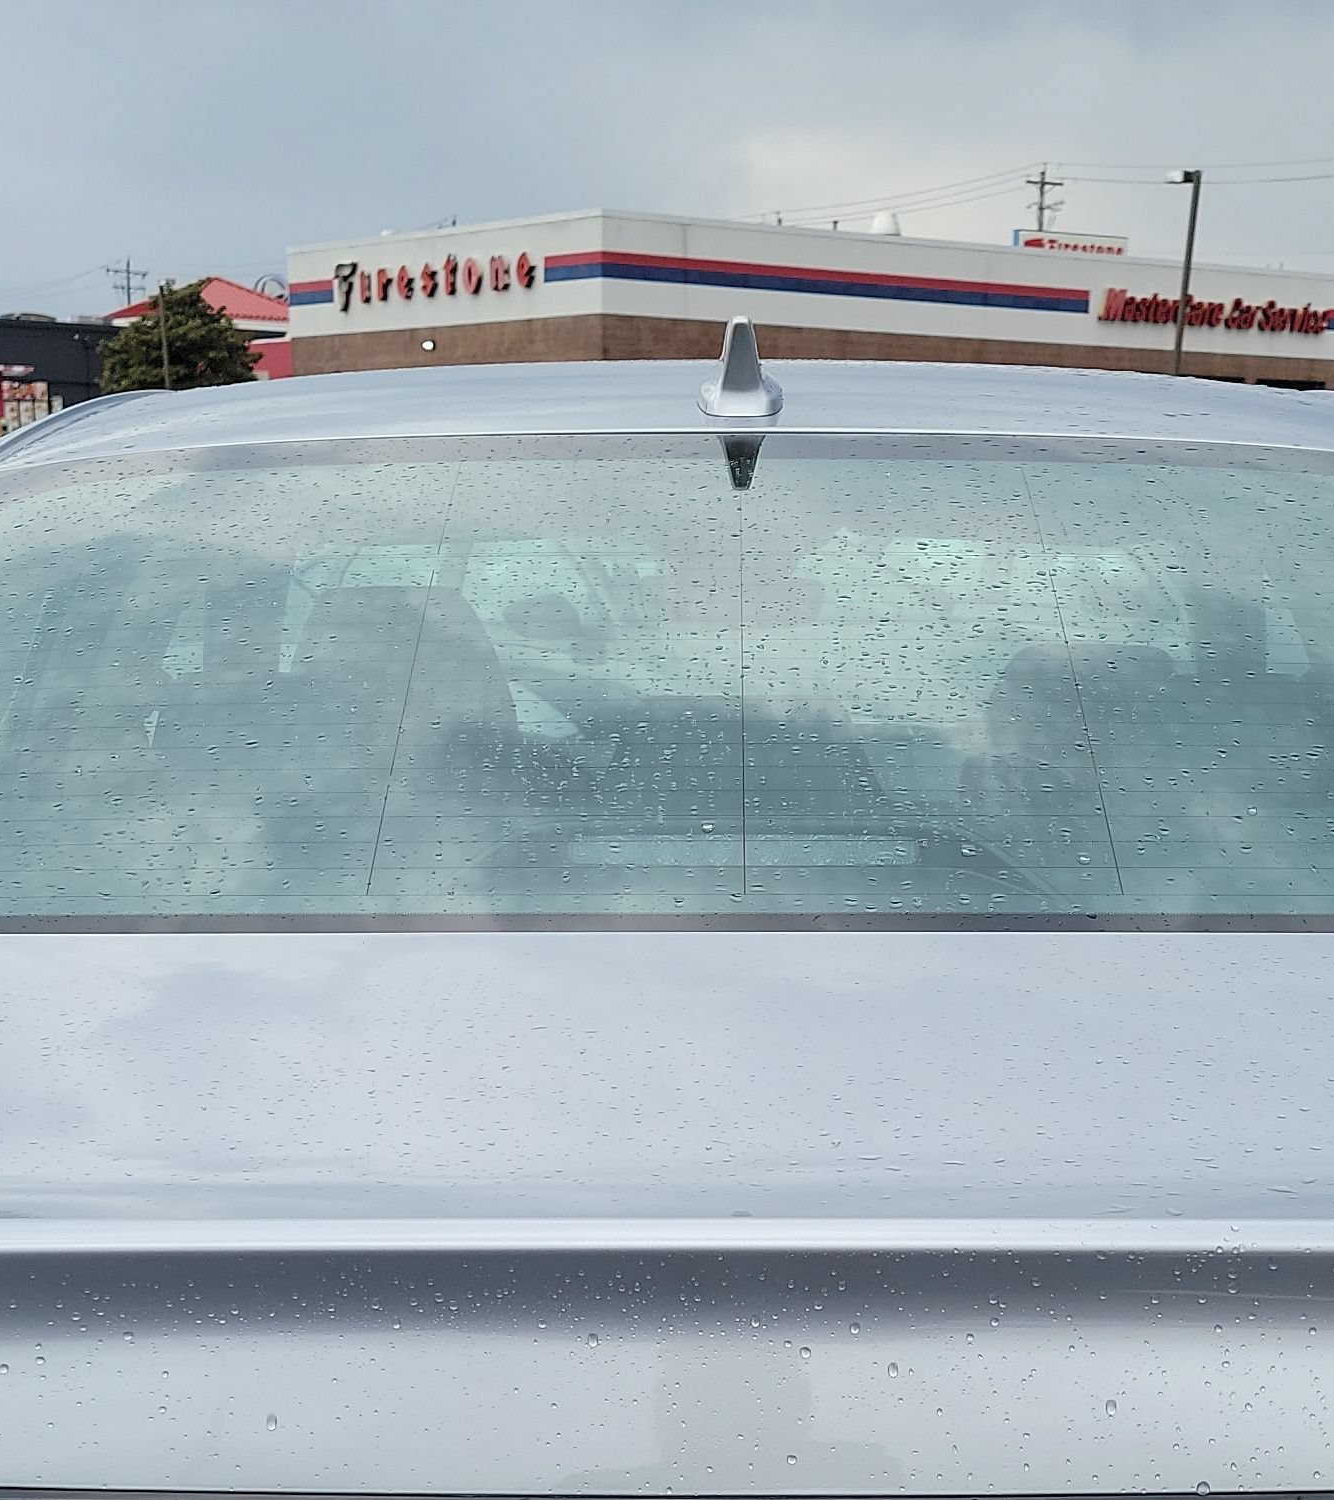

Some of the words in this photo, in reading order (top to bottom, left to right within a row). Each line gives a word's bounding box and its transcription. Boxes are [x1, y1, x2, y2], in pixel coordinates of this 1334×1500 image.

[1048, 238, 1124, 256] Firestone
[334, 251, 536, 312] Firestone
[1224, 297, 1261, 330] Car
